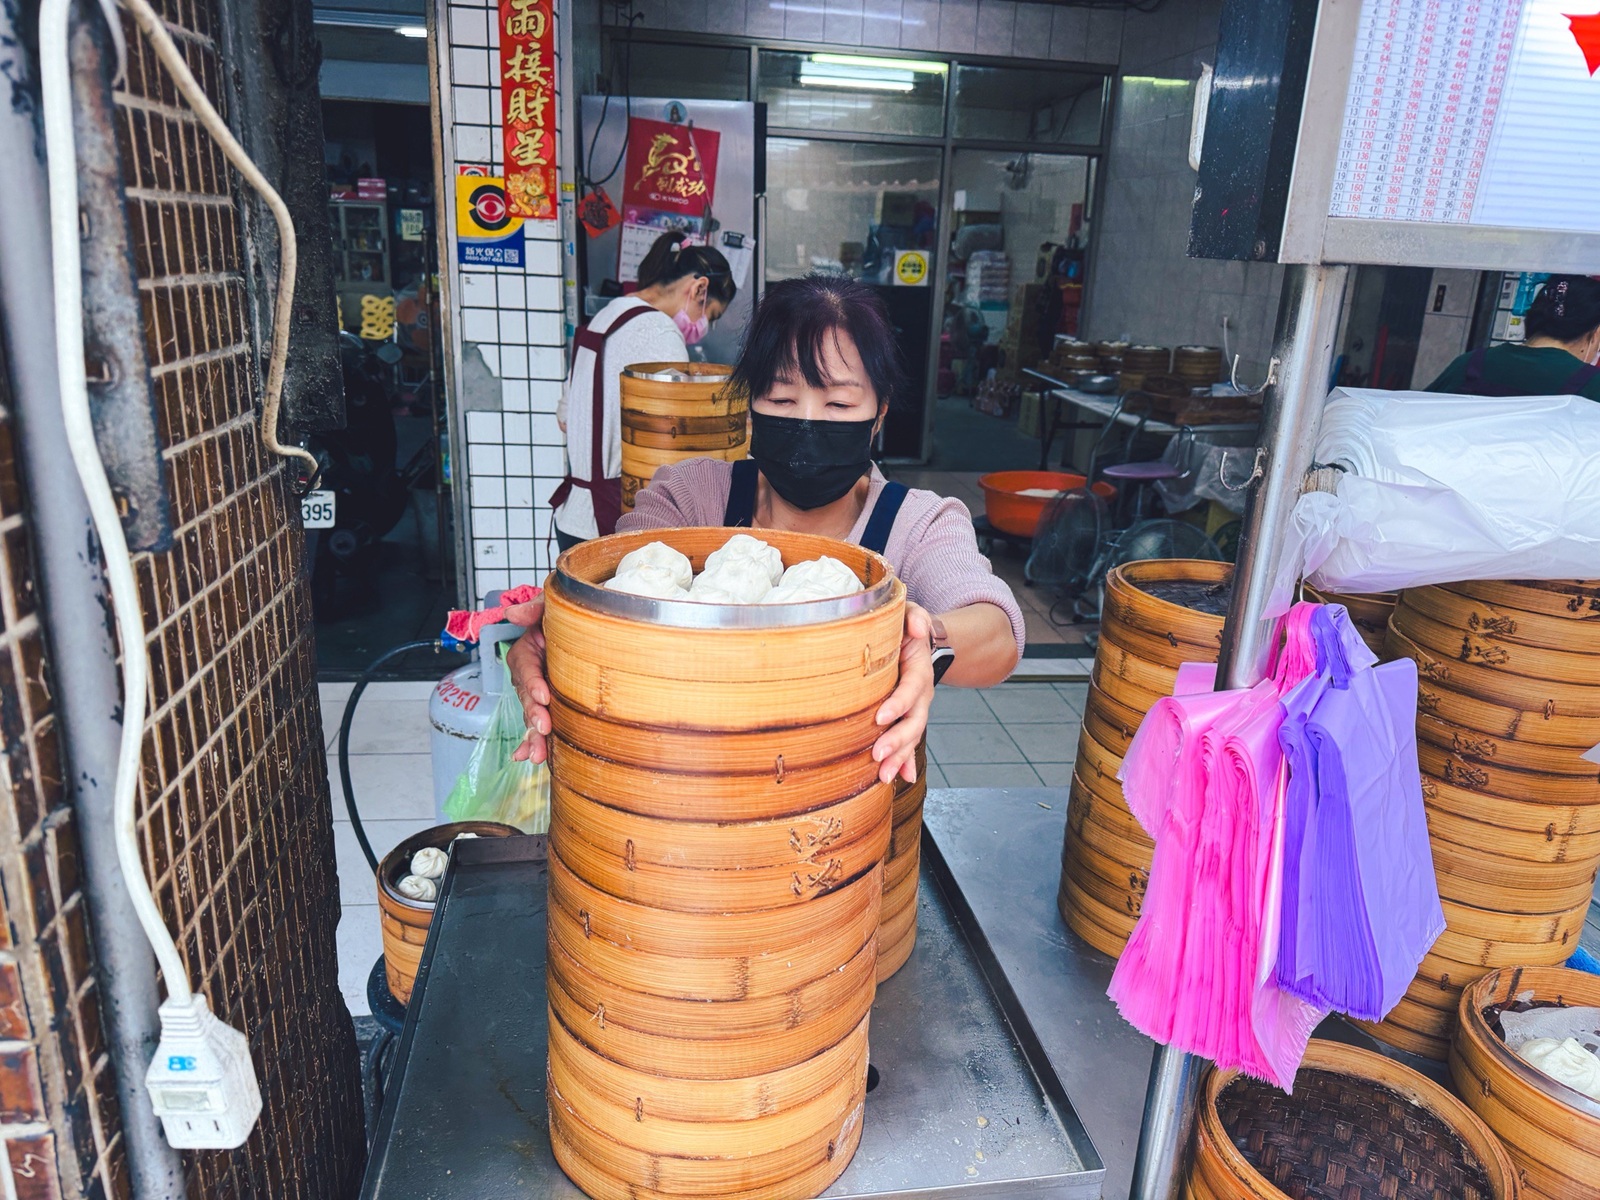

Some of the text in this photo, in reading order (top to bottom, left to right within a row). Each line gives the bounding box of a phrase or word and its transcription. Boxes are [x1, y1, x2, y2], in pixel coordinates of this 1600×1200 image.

[1379, 65, 1387, 74] 72
[1398, 67, 1406, 75] 34
[1413, 69, 1426, 77] 272
[1437, 70, 1445, 79] 59
[1475, 74, 1484, 82] 84
[1375, 76, 1385, 85] 80
[1411, 80, 1424, 88] 280
[1434, 81, 1443, 90] 60
[1472, 85, 1481, 93] 85
[1374, 87, 1382, 96] 88
[1409, 91, 1421, 99] 288
[1432, 92, 1441, 100] 61
[1470, 96, 1478, 104] 86
[1372, 98, 1380, 107] 96
[1406, 102, 1419, 110] 296
[1429, 103, 1438, 111] 62
[1467, 106, 1476, 115] 87
[1366, 109, 1378, 117] 104
[1404, 112, 1417, 120] 304
[1427, 114, 1436, 122] 63
[1442, 115, 1455, 124] 504
[1464, 117, 1473, 125] 88
[1480, 118, 1492, 127] 704
[1364, 120, 1376, 128] 112
[1402, 123, 1414, 131] 312
[1424, 124, 1433, 133] 64
[1440, 125, 1452, 134] 512
[1462, 128, 1471, 136] 89
[1478, 129, 1490, 138] 712
[1362, 130, 1374, 139] 120
[1400, 134, 1412, 142] 320
[1437, 136, 1450, 145] 520
[1459, 138, 1468, 146] 90
[1475, 139, 1487, 148] 720
[1359, 141, 1371, 149] 128
[1397, 144, 1409, 152] 328
[1435, 147, 1447, 156] 528
[1457, 149, 1466, 157] 91
[1472, 150, 1484, 158] 728
[1355, 162, 1367, 170] 144
[1392, 165, 1404, 173] 344
[1430, 168, 1442, 176] 544
[1467, 170, 1478, 179] 744
[1394, 155, 1407, 163] 336
[1432, 157, 1444, 166] 536
[1454, 159, 1463, 167] 92
[1469, 160, 1481, 169] 736
[1353, 173, 1365, 181] 152
[1390, 176, 1402, 184] 352
[1427, 178, 1439, 186] 552
[1465, 181, 1476, 189] 752
[1351, 183, 1363, 191] 160
[1388, 186, 1400, 194] 360
[1425, 188, 1437, 196] 560
[1462, 191, 1474, 199] 760
[1349, 194, 1361, 202] 168
[1386, 196, 1398, 204] 368
[1460, 201, 1471, 209] 768
[1347, 204, 1359, 212] 176
[1384, 207, 1396, 215] 376
[1458, 212, 1469, 220] 776
[302, 503, 332, 521] 395
